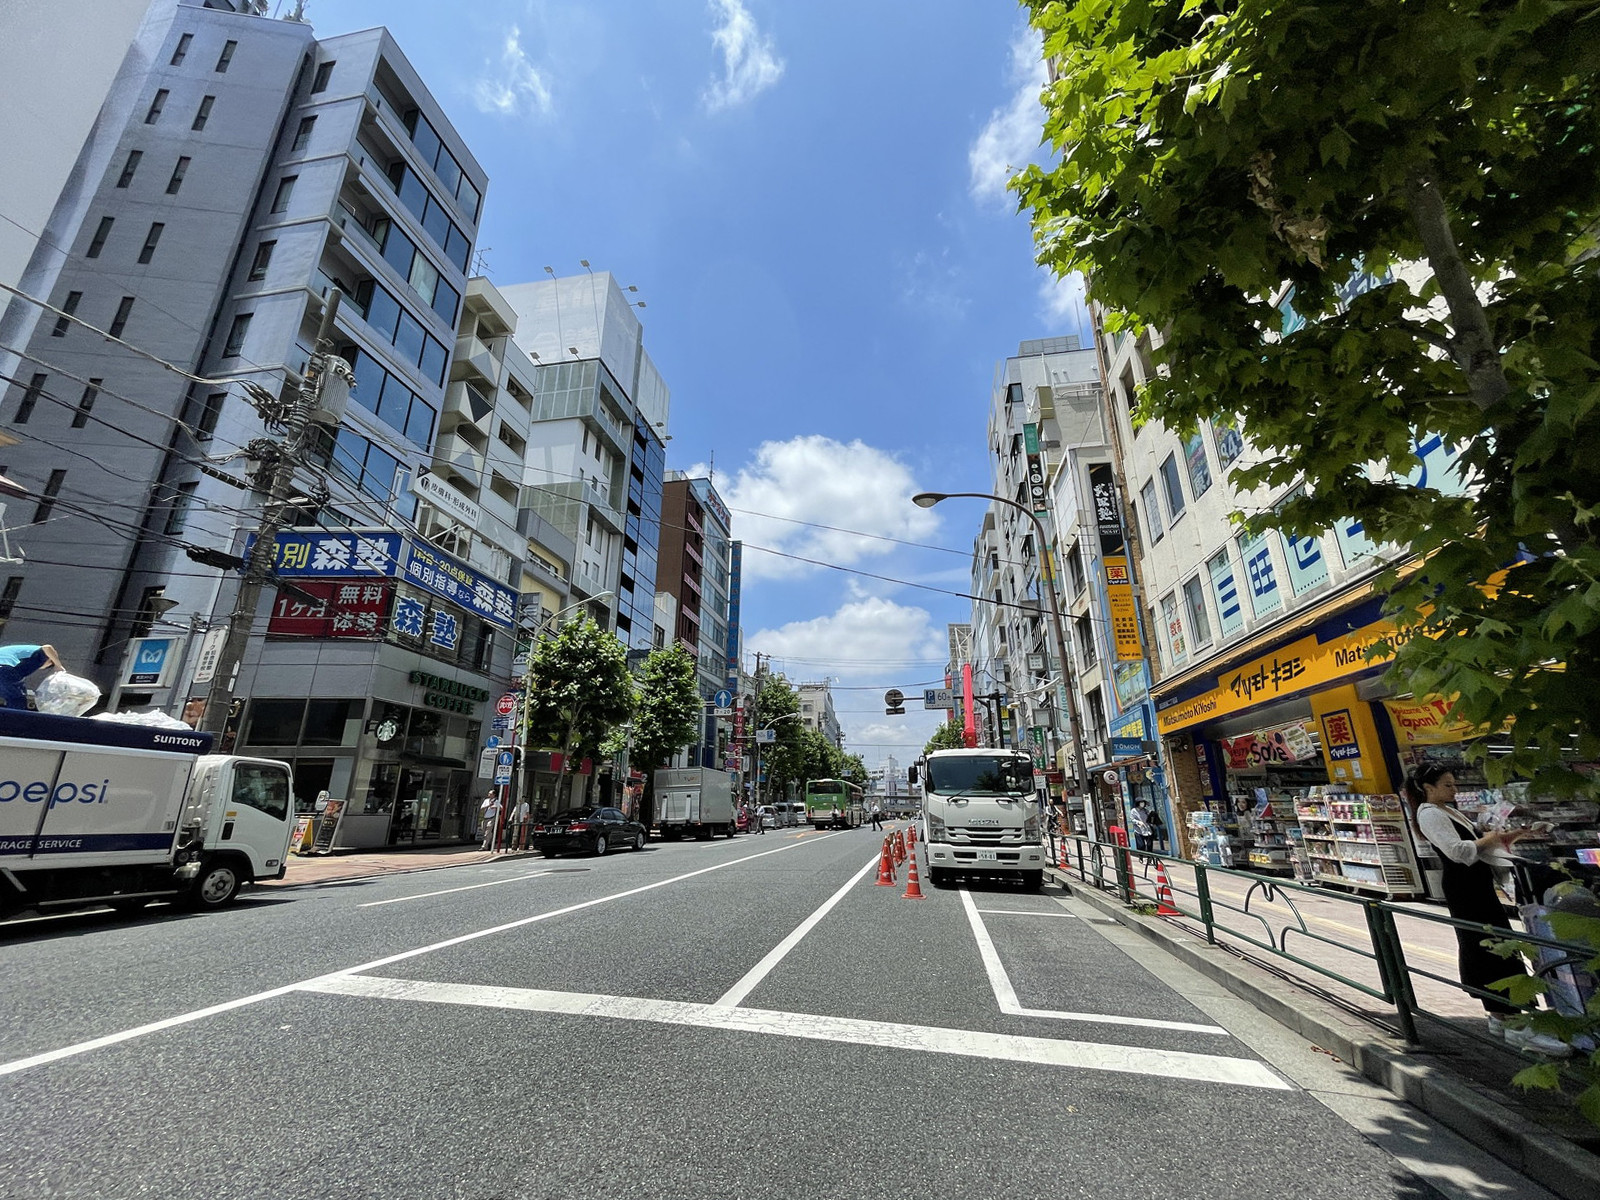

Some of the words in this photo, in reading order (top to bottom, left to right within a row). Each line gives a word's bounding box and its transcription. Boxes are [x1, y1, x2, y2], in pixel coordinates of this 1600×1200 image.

[430, 482, 478, 518] 皮膚科・形成外科
[311, 537, 392, 571] 森塾
[409, 560, 472, 603] 個別指導なら
[1109, 567, 1124, 579] 薬
[337, 584, 383, 605] 無料
[472, 579, 514, 624] 森塾
[333, 611, 379, 632] 体験
[392, 596, 459, 651] 森塾
[411, 670, 490, 702] STARBUCKS
[1230, 657, 1306, 701] マツモトキヨシ
[424, 692, 475, 716] COFFEE
[1163, 710, 1193, 727] Matsumoto
[1193, 700, 1217, 716] KiYoshi
[1326, 715, 1351, 745] 薬
[1250, 738, 1290, 763] Sale
[0, 840, 33, 851] RAGE
[38, 838, 83, 849] SERVICE
